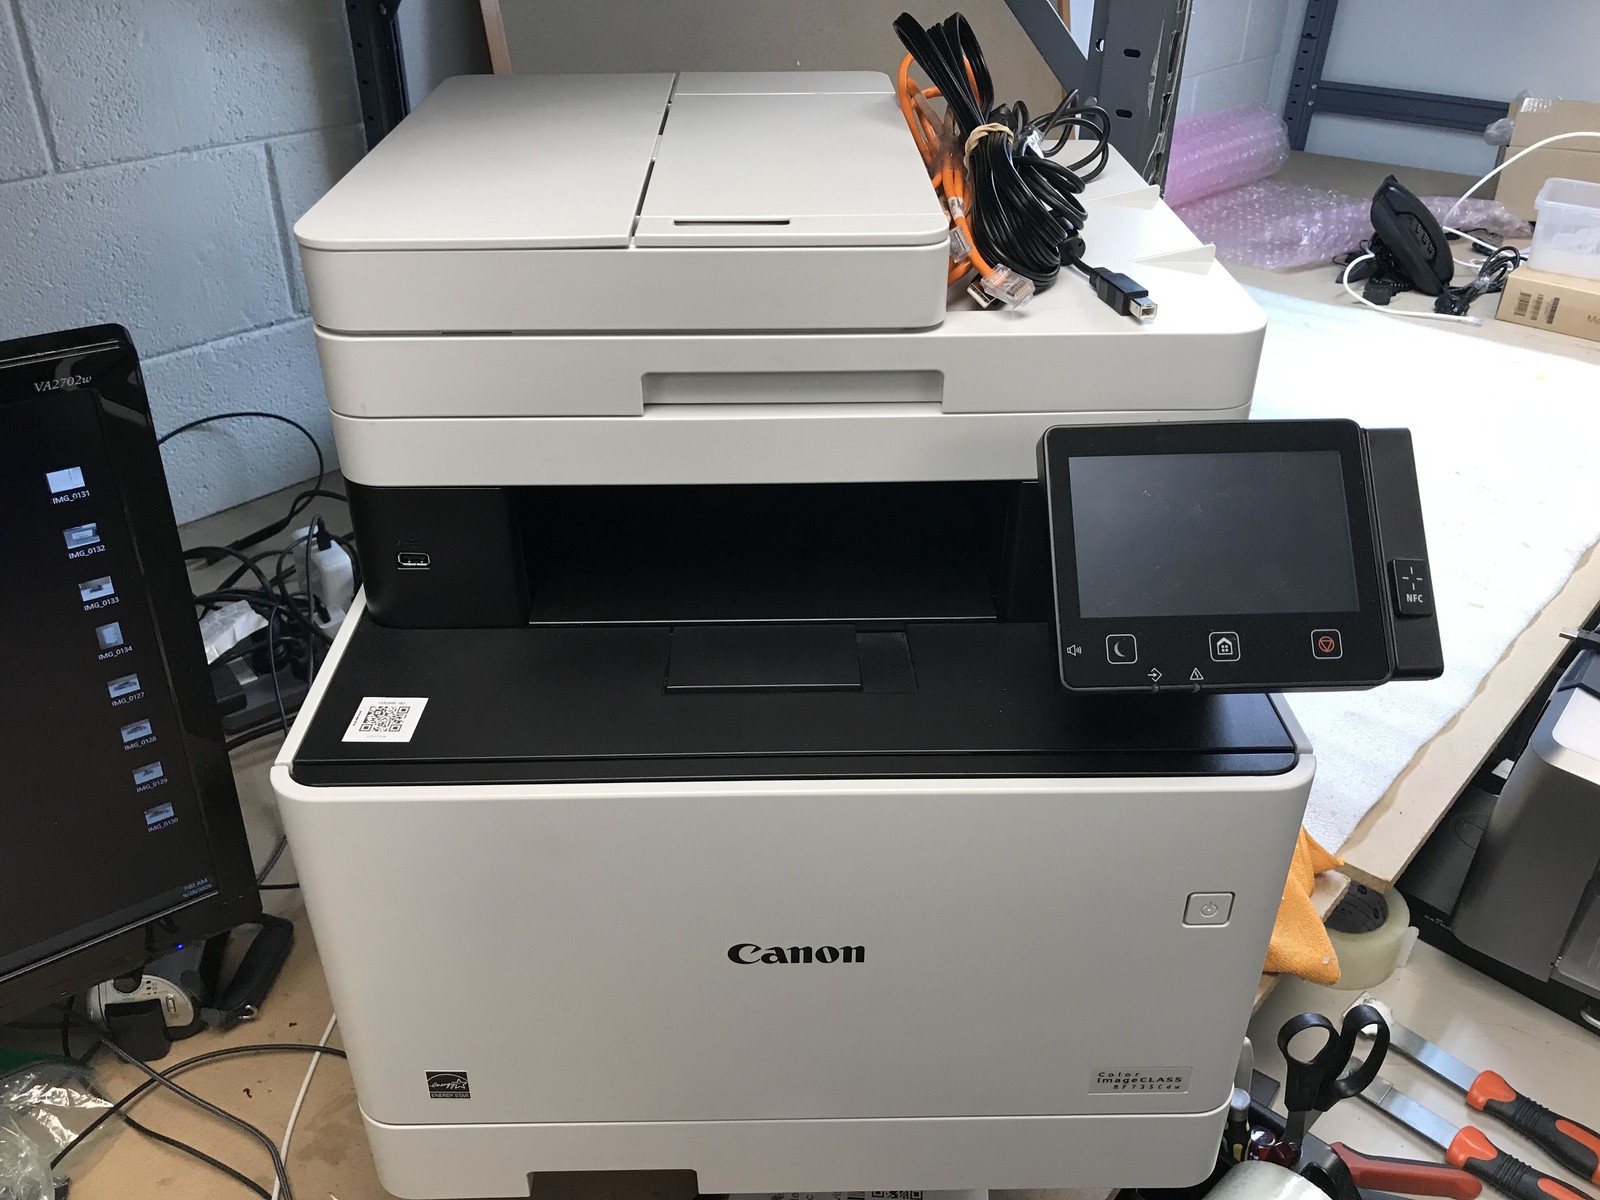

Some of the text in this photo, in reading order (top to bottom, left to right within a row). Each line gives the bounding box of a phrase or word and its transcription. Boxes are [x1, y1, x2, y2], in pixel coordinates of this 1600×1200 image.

[34, 375, 92, 392] VA2702w
[52, 490, 90, 505] IMG_0131
[68, 544, 106, 560] IMG_0132
[83, 596, 120, 612] IMG_0133
[1406, 593, 1424, 603] NFC
[98, 645, 133, 661] IMG_0134
[111, 691, 145, 707] IMG_0127
[124, 735, 157, 751] IMG_0128
[136, 777, 168, 793] IMG_0129
[727, 943, 865, 965] Canon
